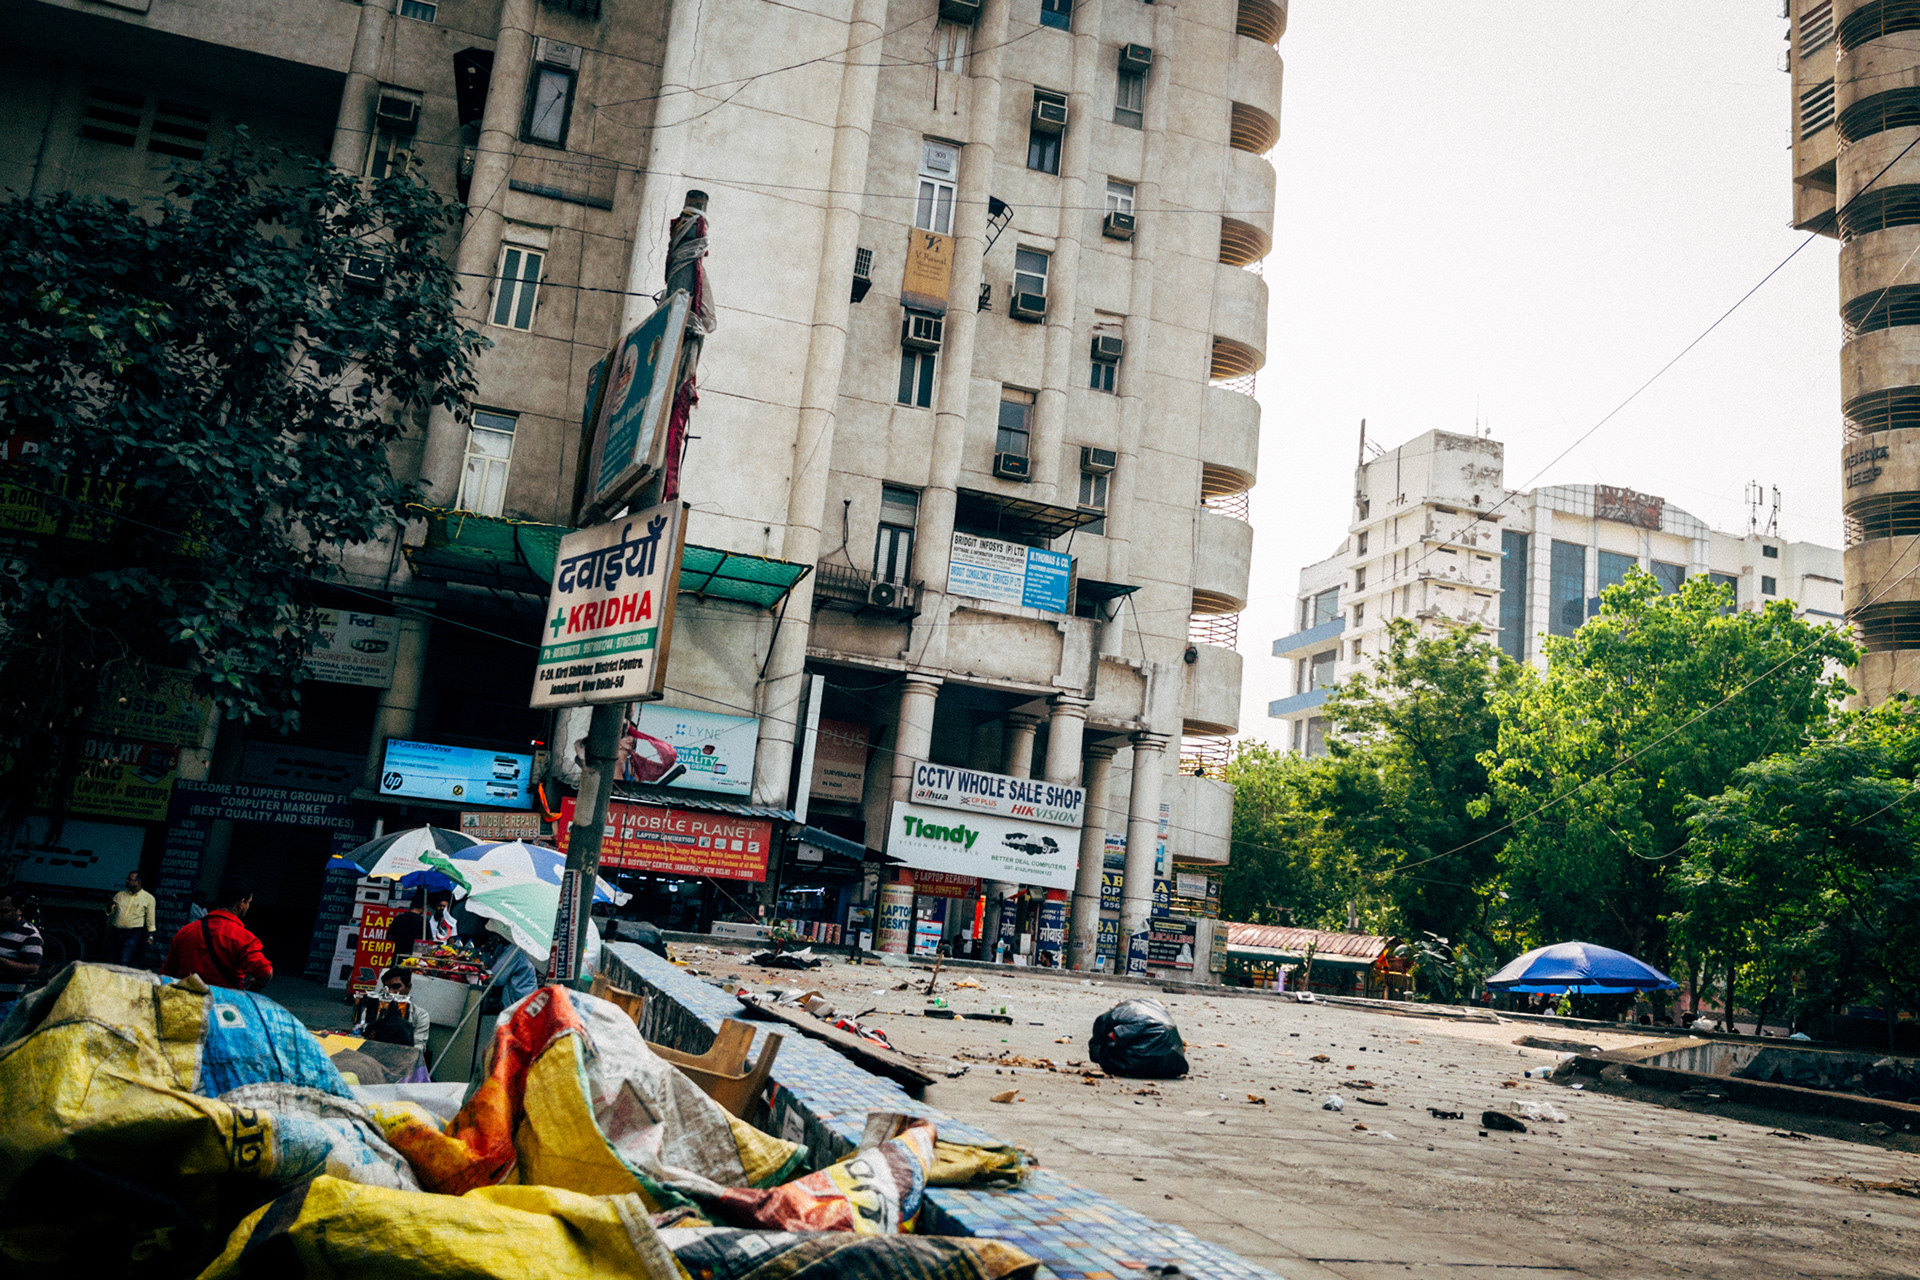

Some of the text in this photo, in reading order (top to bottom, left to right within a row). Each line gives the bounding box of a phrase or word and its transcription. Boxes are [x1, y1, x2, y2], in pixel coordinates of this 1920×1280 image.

[1847, 467, 1882, 490] DEEP
[954, 535, 978, 548] BRIDGIT
[980, 538, 1004, 553] INFOSYS
[567, 590, 653, 635] KRIDHA
[352, 640, 388, 652] ups
[594, 660, 619, 675] District
[582, 680, 596, 692] New
[119, 696, 167, 715] USED
[688, 725, 723, 741] LYNE
[821, 728, 867, 749] PLUS
[400, 741, 428, 751] Certified
[428, 744, 453, 753] Partner
[676, 754, 717, 765] QUALITY
[384, 771, 404, 791] hp
[918, 765, 1082, 810] CCTV WHOLE SALE SHOP
[126, 784, 169, 802] DESKTOPS
[177, 780, 334, 804] WELCOME TO UPPER GROUND
[220, 796, 328, 814] COMPUTER MARKET
[1011, 804, 1078, 824] HIKVISION
[189, 804, 355, 830] (BEST QUALITY AND SERVICES)
[482, 815, 538, 828] MOBILE REPAIR
[168, 828, 206, 840] COMPUTER
[494, 829, 539, 838] BATTERIES
[622, 813, 687, 832] MOBILE
[691, 819, 756, 840] PLANET
[903, 816, 979, 849] Tiandy
[636, 832, 659, 841] LAPTOP
[161, 858, 198, 869] COMPUTER
[990, 854, 1014, 864] BETTER
[1015, 858, 1030, 866] DEAL
[1031, 860, 1067, 871] COMPUTERS
[920, 872, 978, 886] LAPTOP REPAIRING
